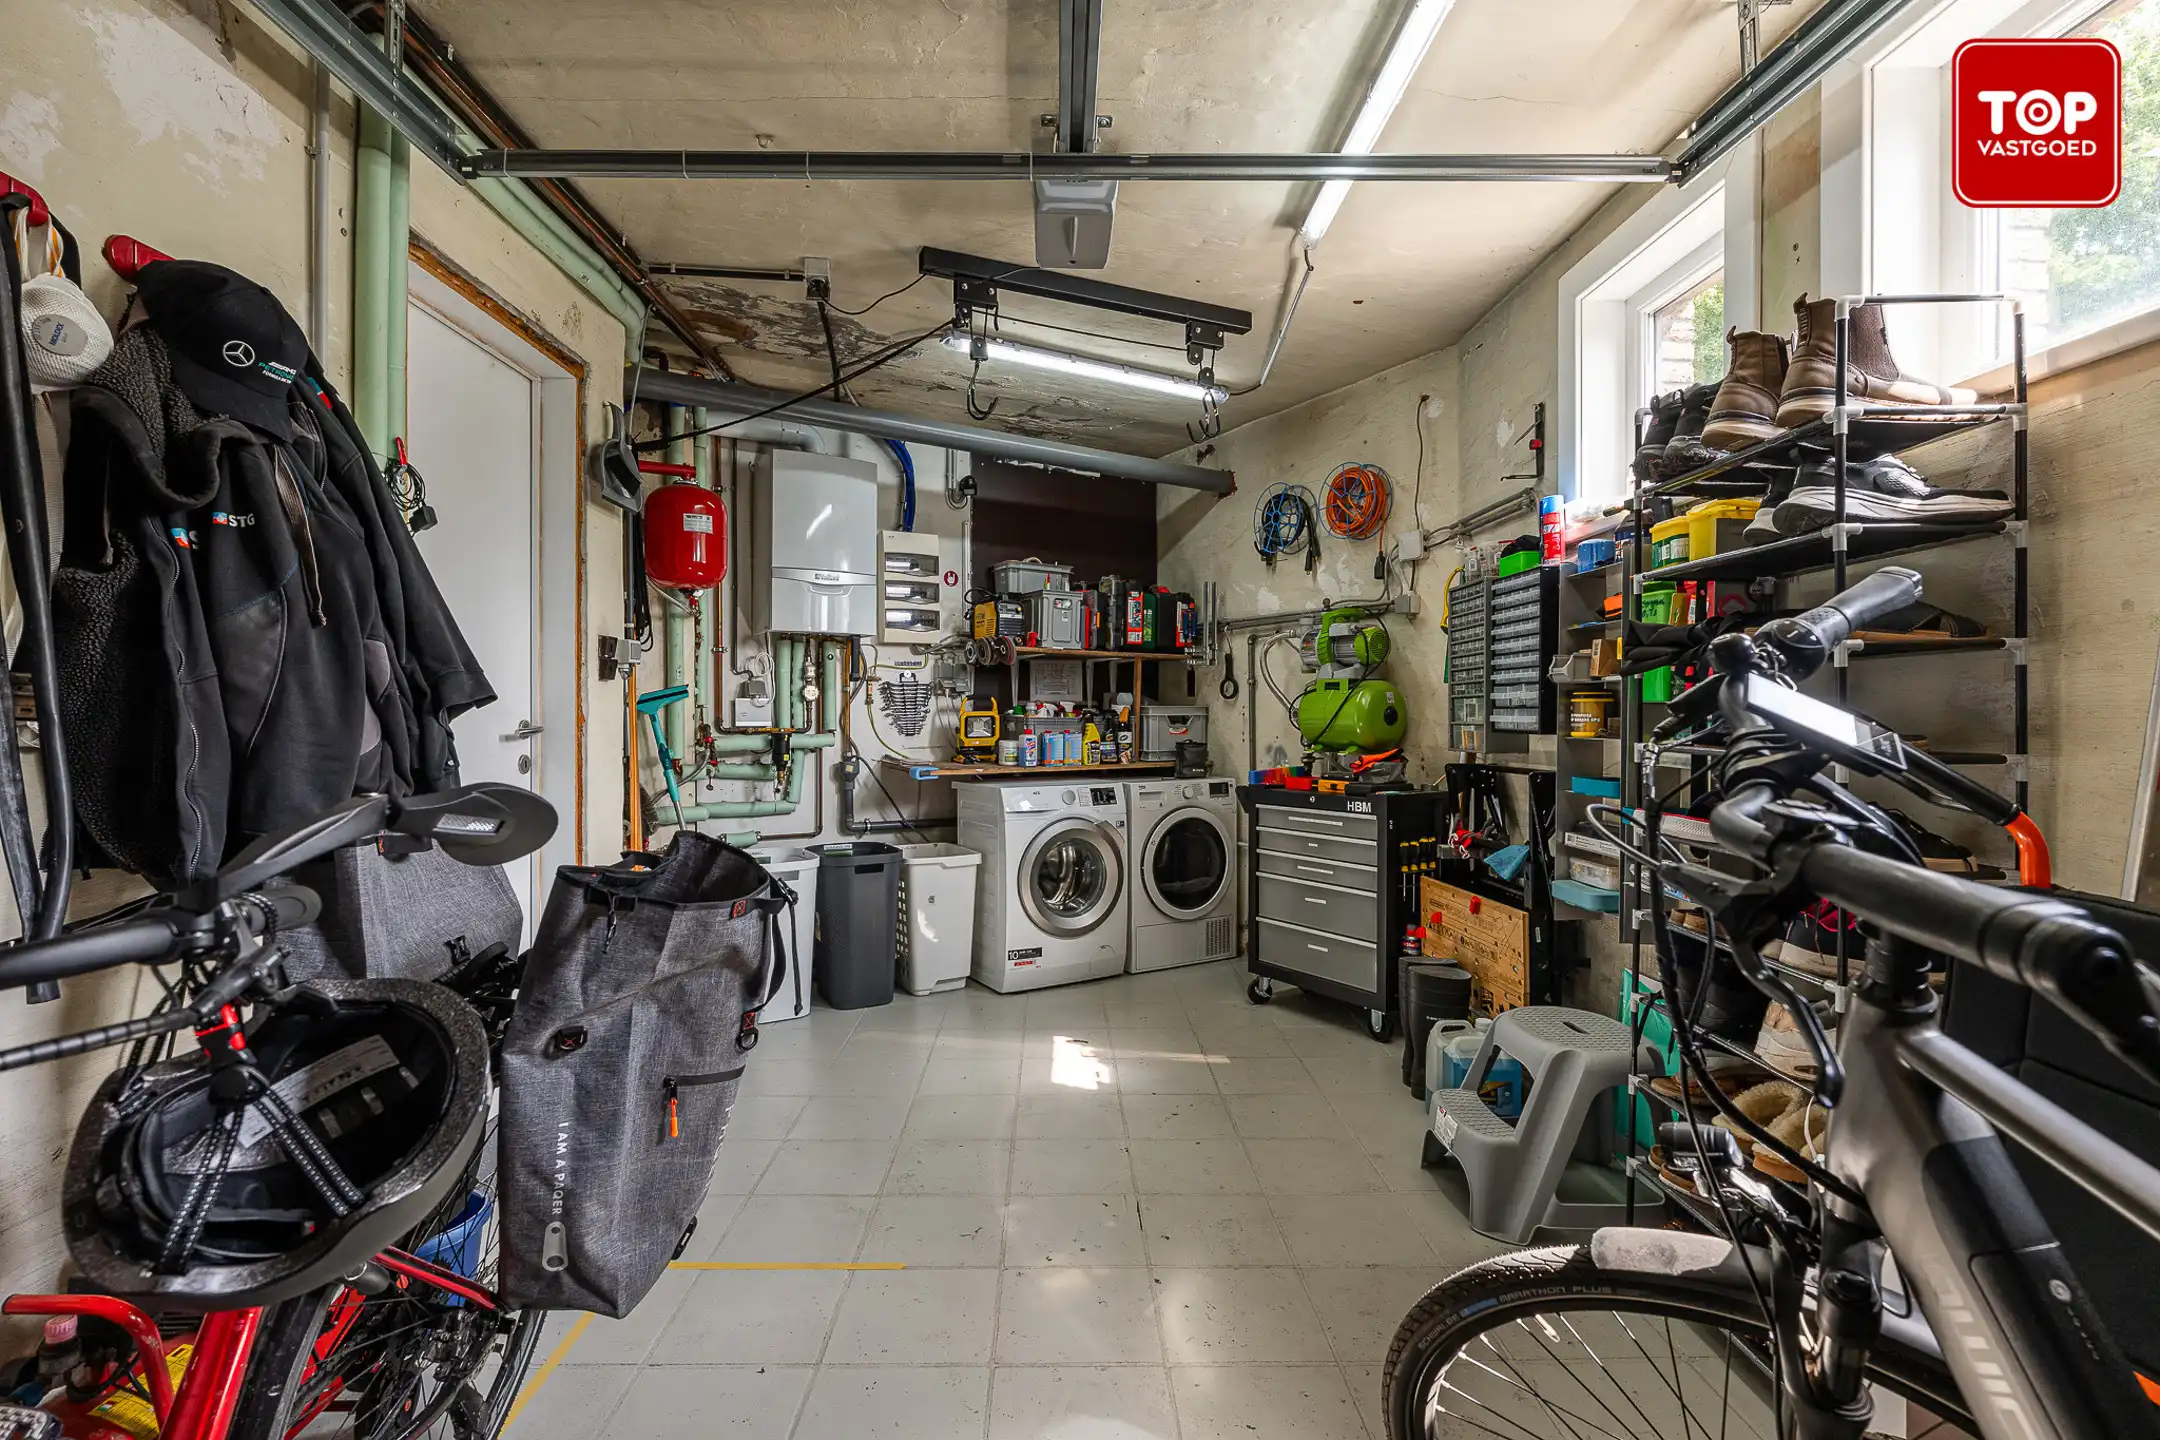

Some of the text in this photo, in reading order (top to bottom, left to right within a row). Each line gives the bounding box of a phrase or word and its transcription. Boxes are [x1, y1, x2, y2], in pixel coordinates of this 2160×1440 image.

[228, 513, 255, 527] STG
[1347, 801, 1372, 813] HBM
[556, 1132, 568, 1155] AM
[555, 1160, 566, 1169] A
[551, 1172, 566, 1216] PAQER
[1499, 1286, 1565, 1302] MARATHON
[1572, 1286, 1612, 1294] PLUS
